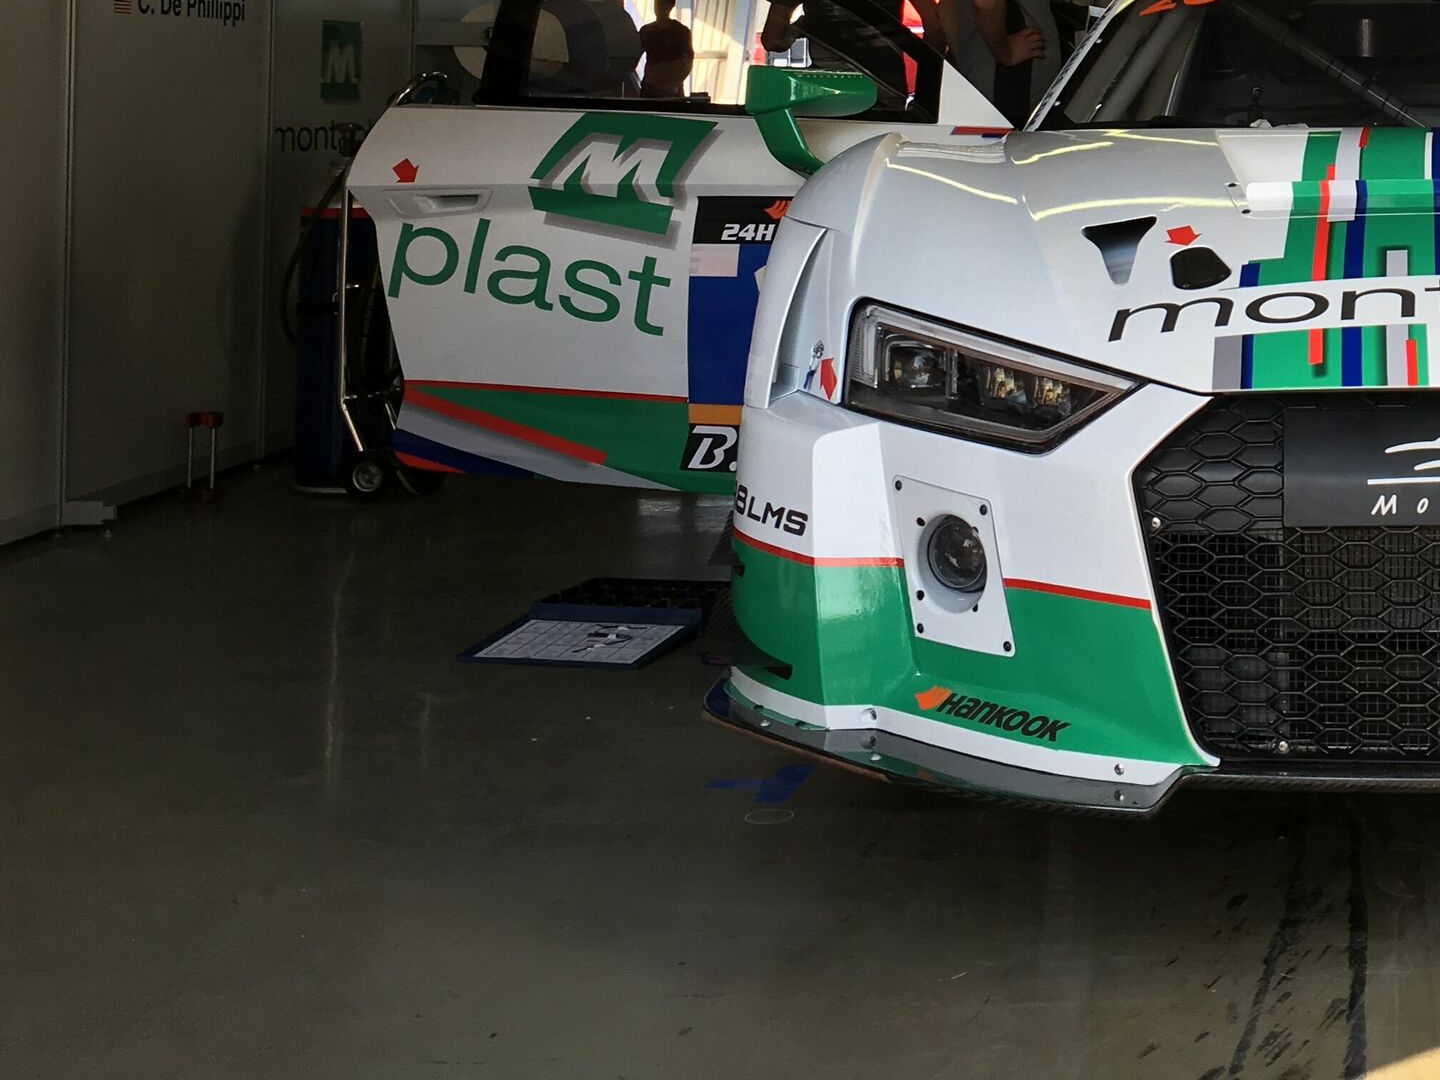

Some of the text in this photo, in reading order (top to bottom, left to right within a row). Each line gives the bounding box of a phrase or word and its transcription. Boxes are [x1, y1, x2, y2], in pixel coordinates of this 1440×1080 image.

[720, 223, 776, 242] 24H
[388, 218, 672, 337] plast
[735, 481, 809, 537] 8LMS
